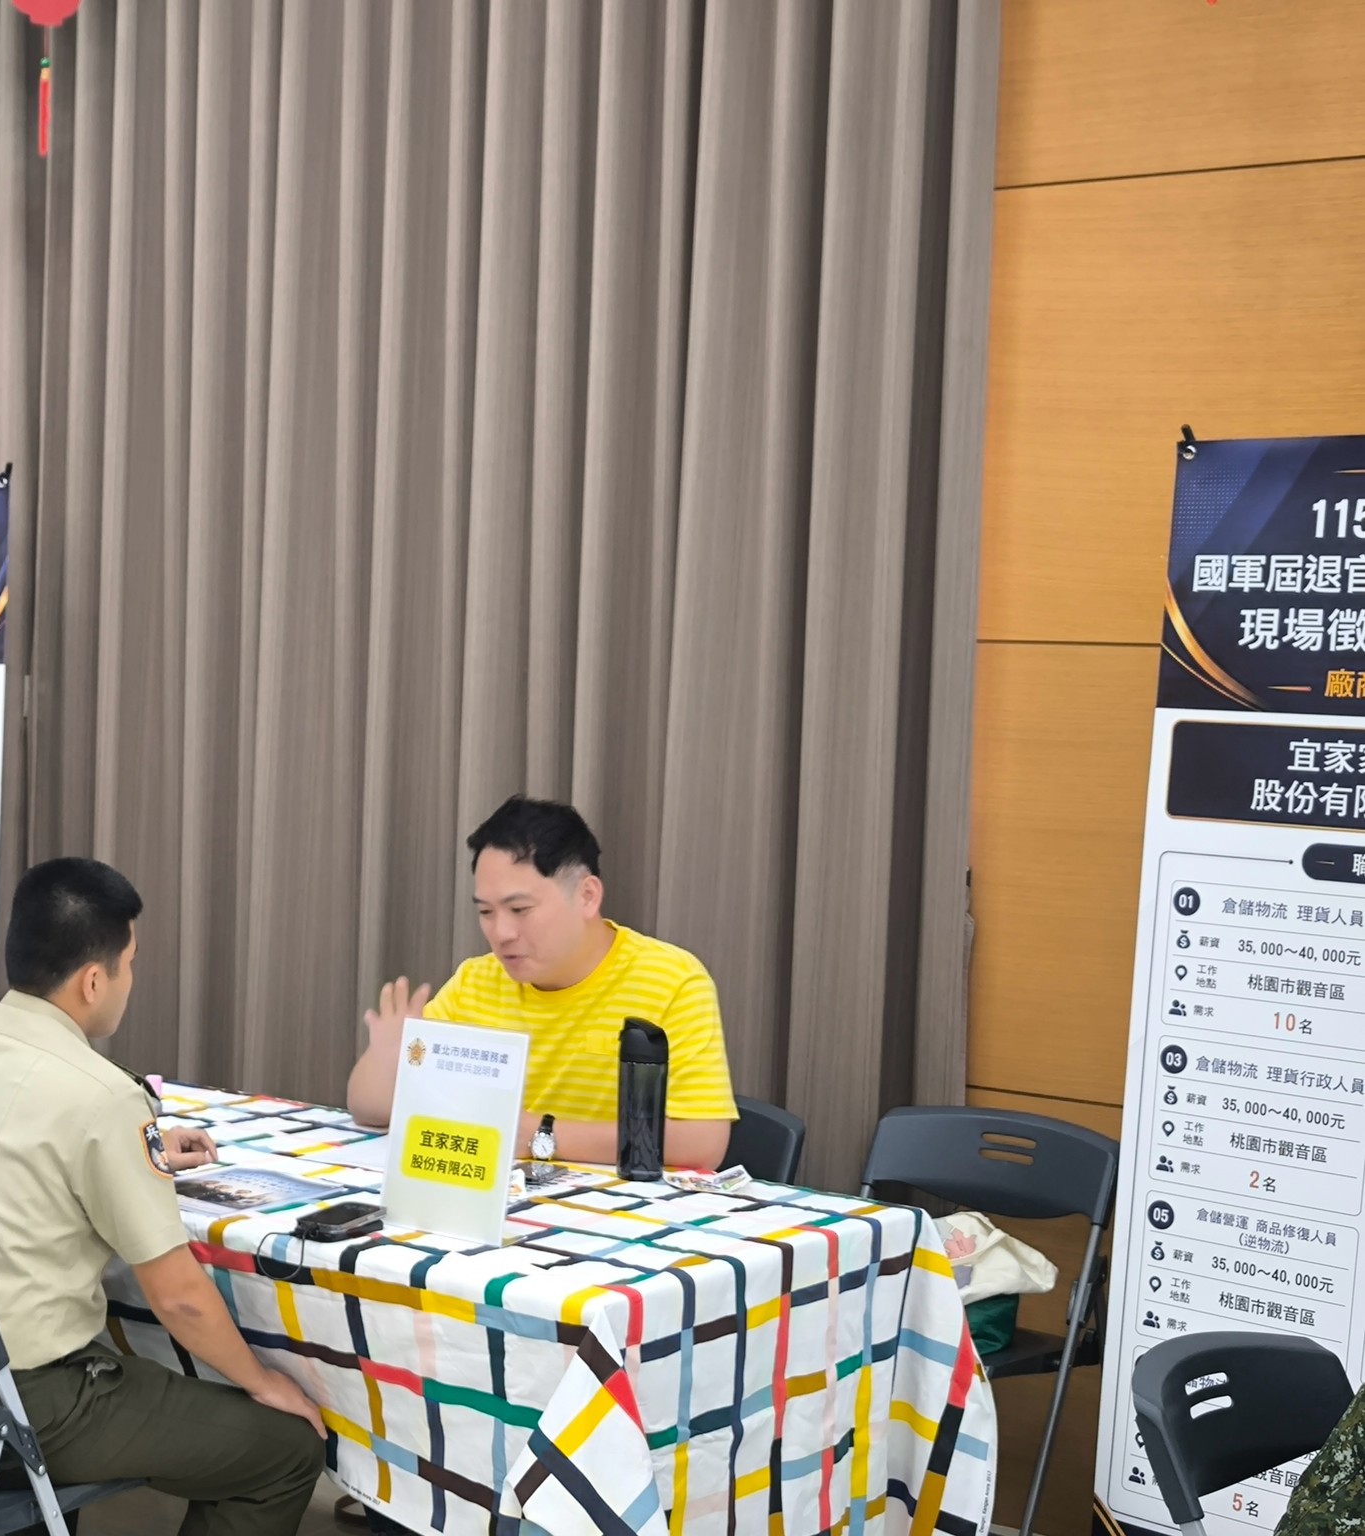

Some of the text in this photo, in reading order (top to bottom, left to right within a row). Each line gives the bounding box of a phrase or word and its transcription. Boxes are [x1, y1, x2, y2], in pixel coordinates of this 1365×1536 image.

[1312, 498, 1365, 538] 115
[1287, 738, 1365, 774] 宜家
[1178, 893, 1194, 910] 01
[1221, 897, 1364, 928] 倉儲物流 理貨人員
[1199, 936, 1220, 949] 薪資
[1196, 964, 1218, 976] 工作
[1195, 977, 1217, 990] 地點
[1246, 974, 1346, 1001] 桃園市觀音區
[1193, 1005, 1215, 1018] 需求
[431, 1043, 509, 1066] 臺北市榮民服務處
[1166, 1052, 1182, 1067] 03
[1195, 1055, 1365, 1096] 倉儲物流 理貨行政人員
[1186, 1092, 1207, 1106] 薪資
[1183, 1121, 1205, 1133] 工作
[419, 1129, 480, 1156] 宜家家居
[1182, 1134, 1204, 1147] 地點
[1229, 1131, 1328, 1164] 桃園市觀音區
[410, 1154, 486, 1182] 股份有限公司
[1180, 1161, 1201, 1175] 需求
[1152, 1207, 1169, 1223] 05
[1196, 1207, 1337, 1247] 倉儲營運 商品修復人員
[1172, 1249, 1194, 1264] 薪資
[1170, 1277, 1192, 1291] 工作
[1169, 1290, 1191, 1305] 地點
[1218, 1291, 1316, 1327] 桃園市觀音區
[1166, 1317, 1188, 1332] 需求
